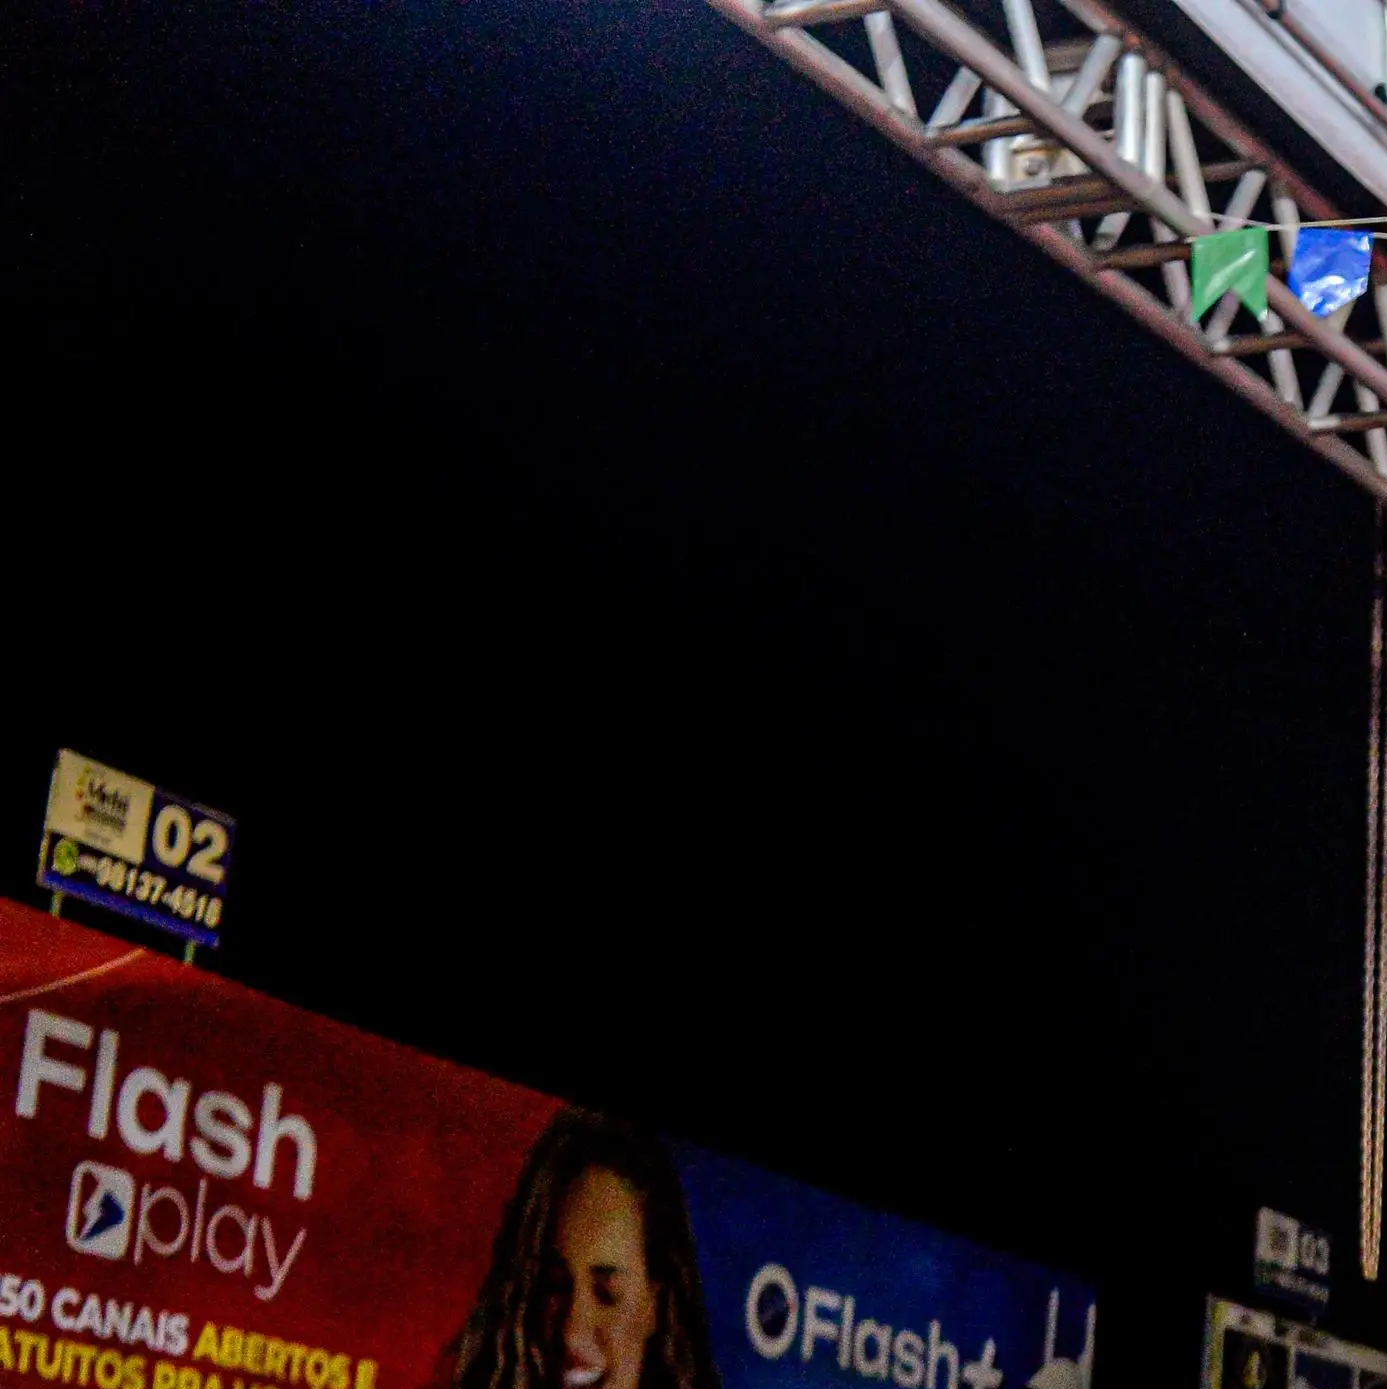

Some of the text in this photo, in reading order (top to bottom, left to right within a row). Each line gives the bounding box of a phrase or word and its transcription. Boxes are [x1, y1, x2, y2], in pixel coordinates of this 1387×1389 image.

[152, 803, 229, 885] 02
[14, 1008, 319, 1201] Flash
[133, 1177, 307, 1300] play
[50, 1286, 190, 1357] CANAIS
